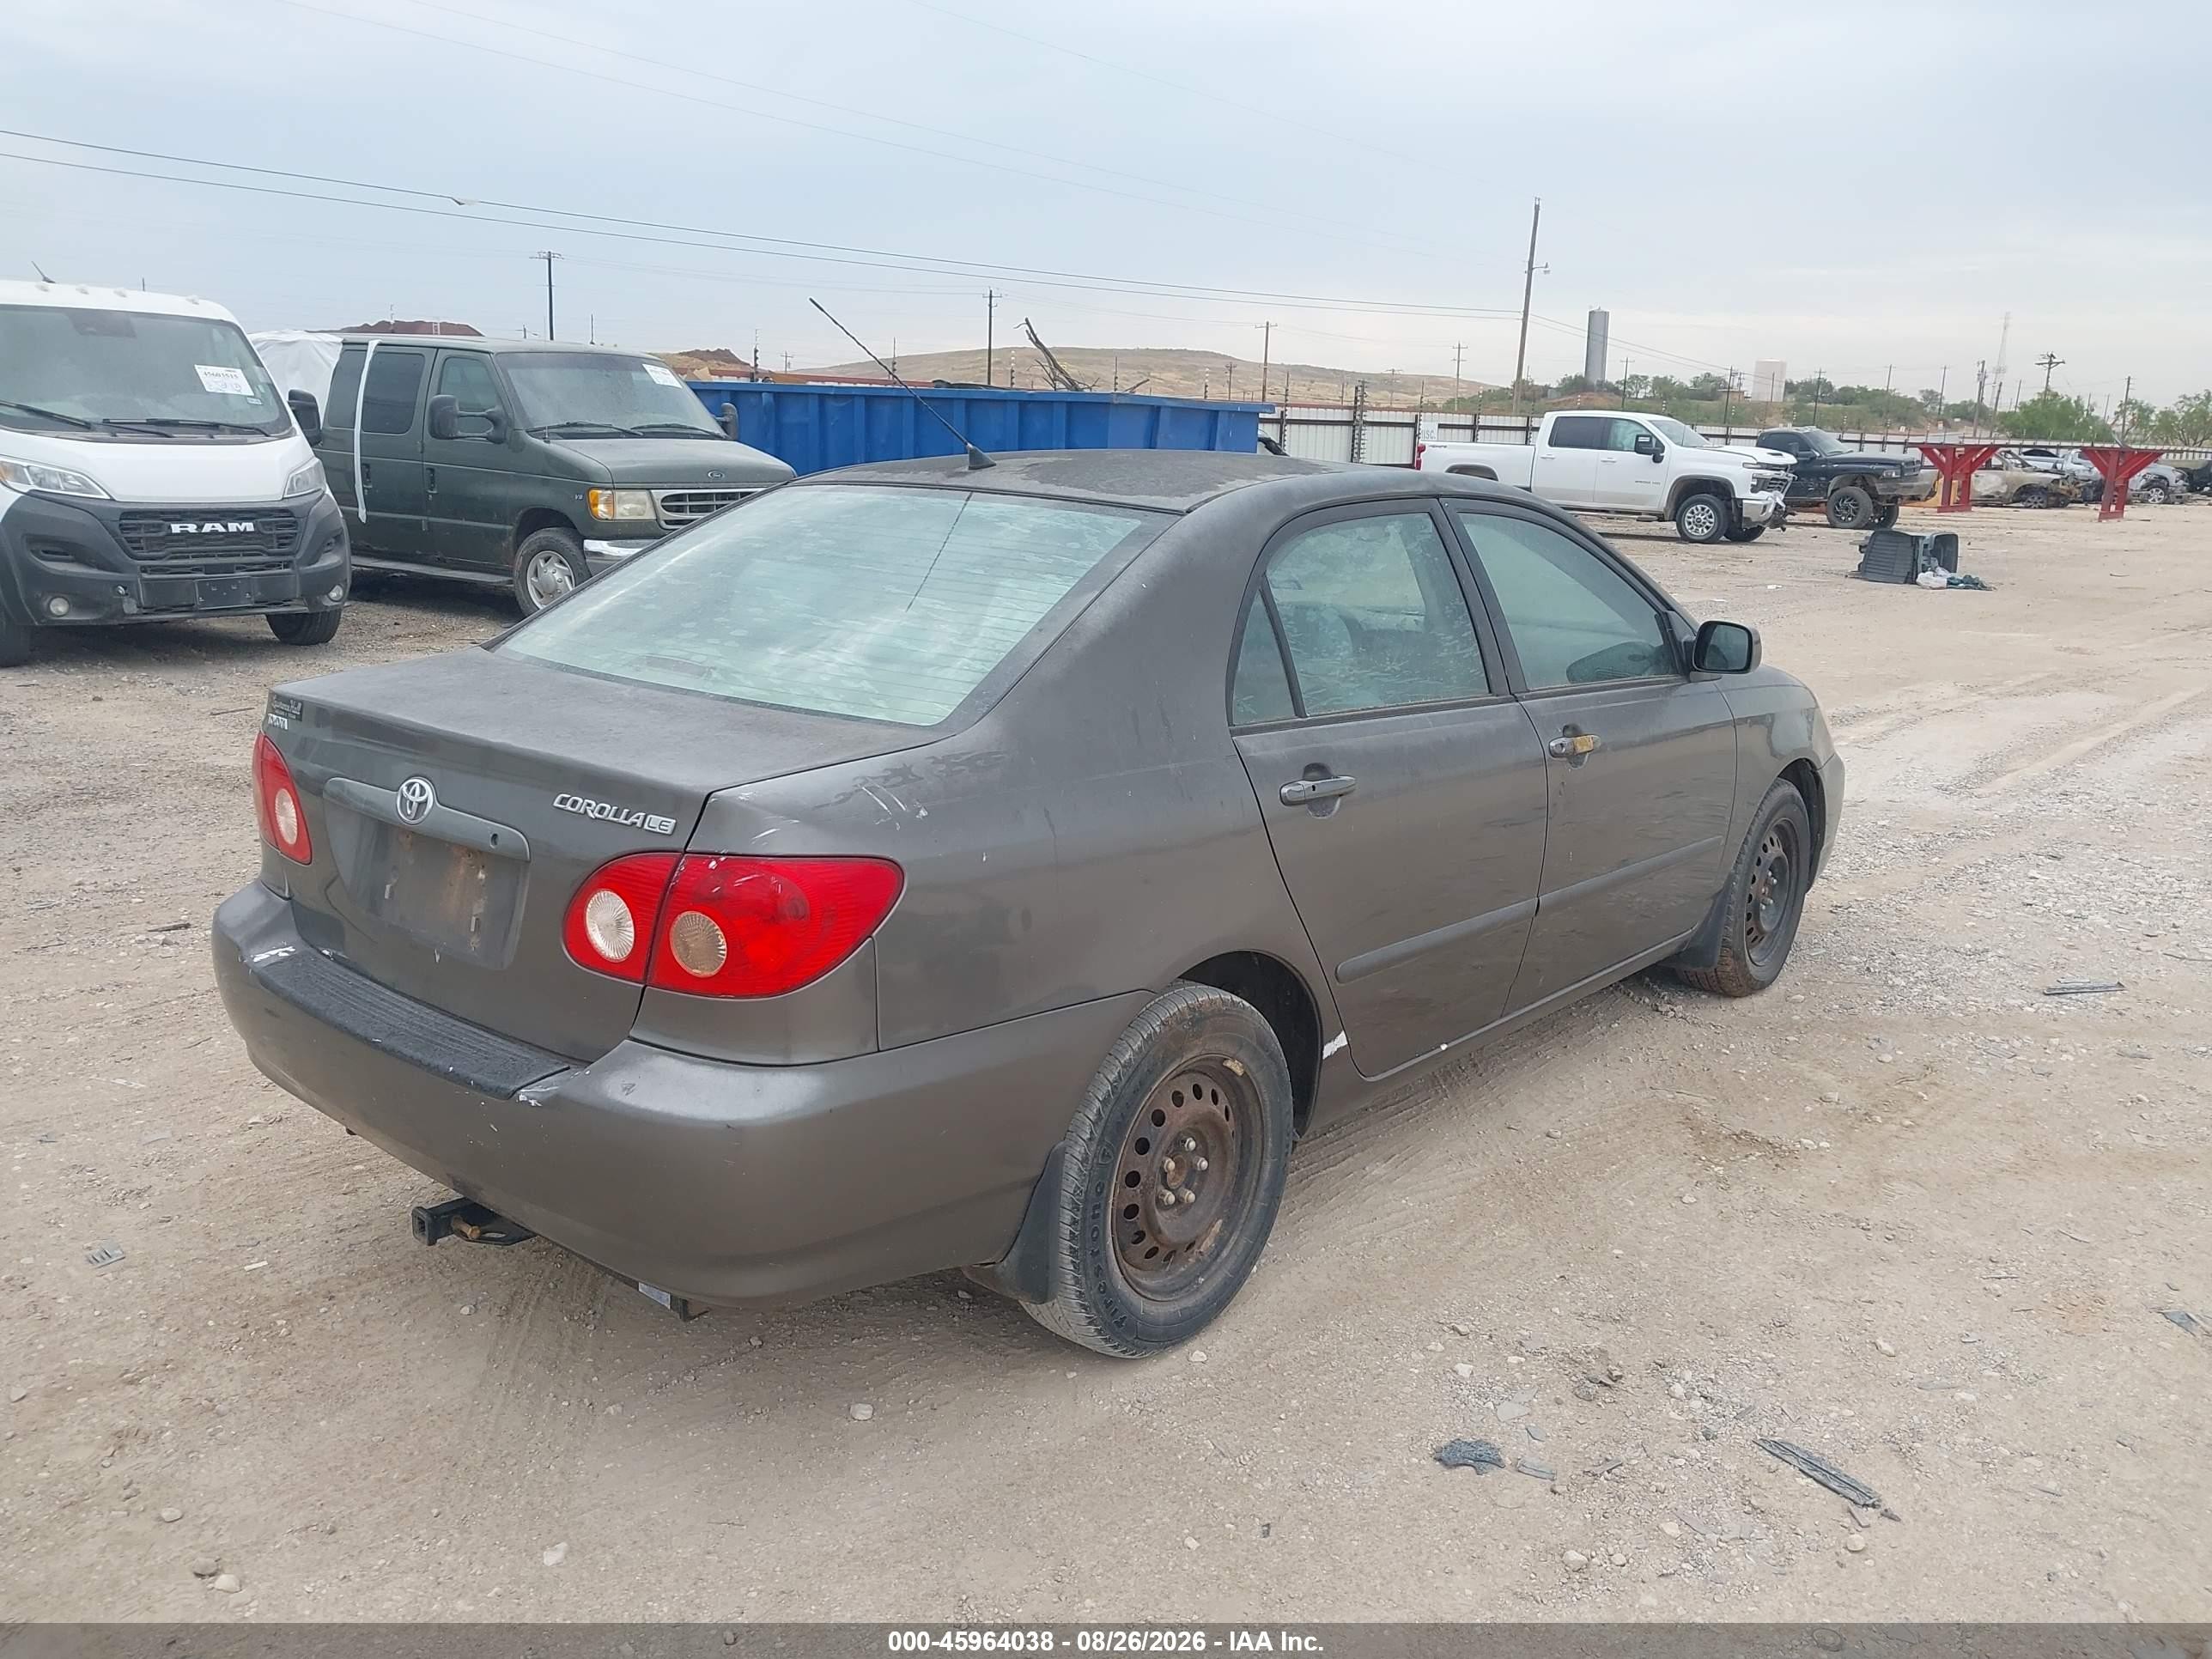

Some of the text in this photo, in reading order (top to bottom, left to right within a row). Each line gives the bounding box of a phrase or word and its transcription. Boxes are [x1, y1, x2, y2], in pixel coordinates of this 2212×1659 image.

[171, 522, 255, 533] RAM
[553, 793, 675, 834] COROLLA LE
